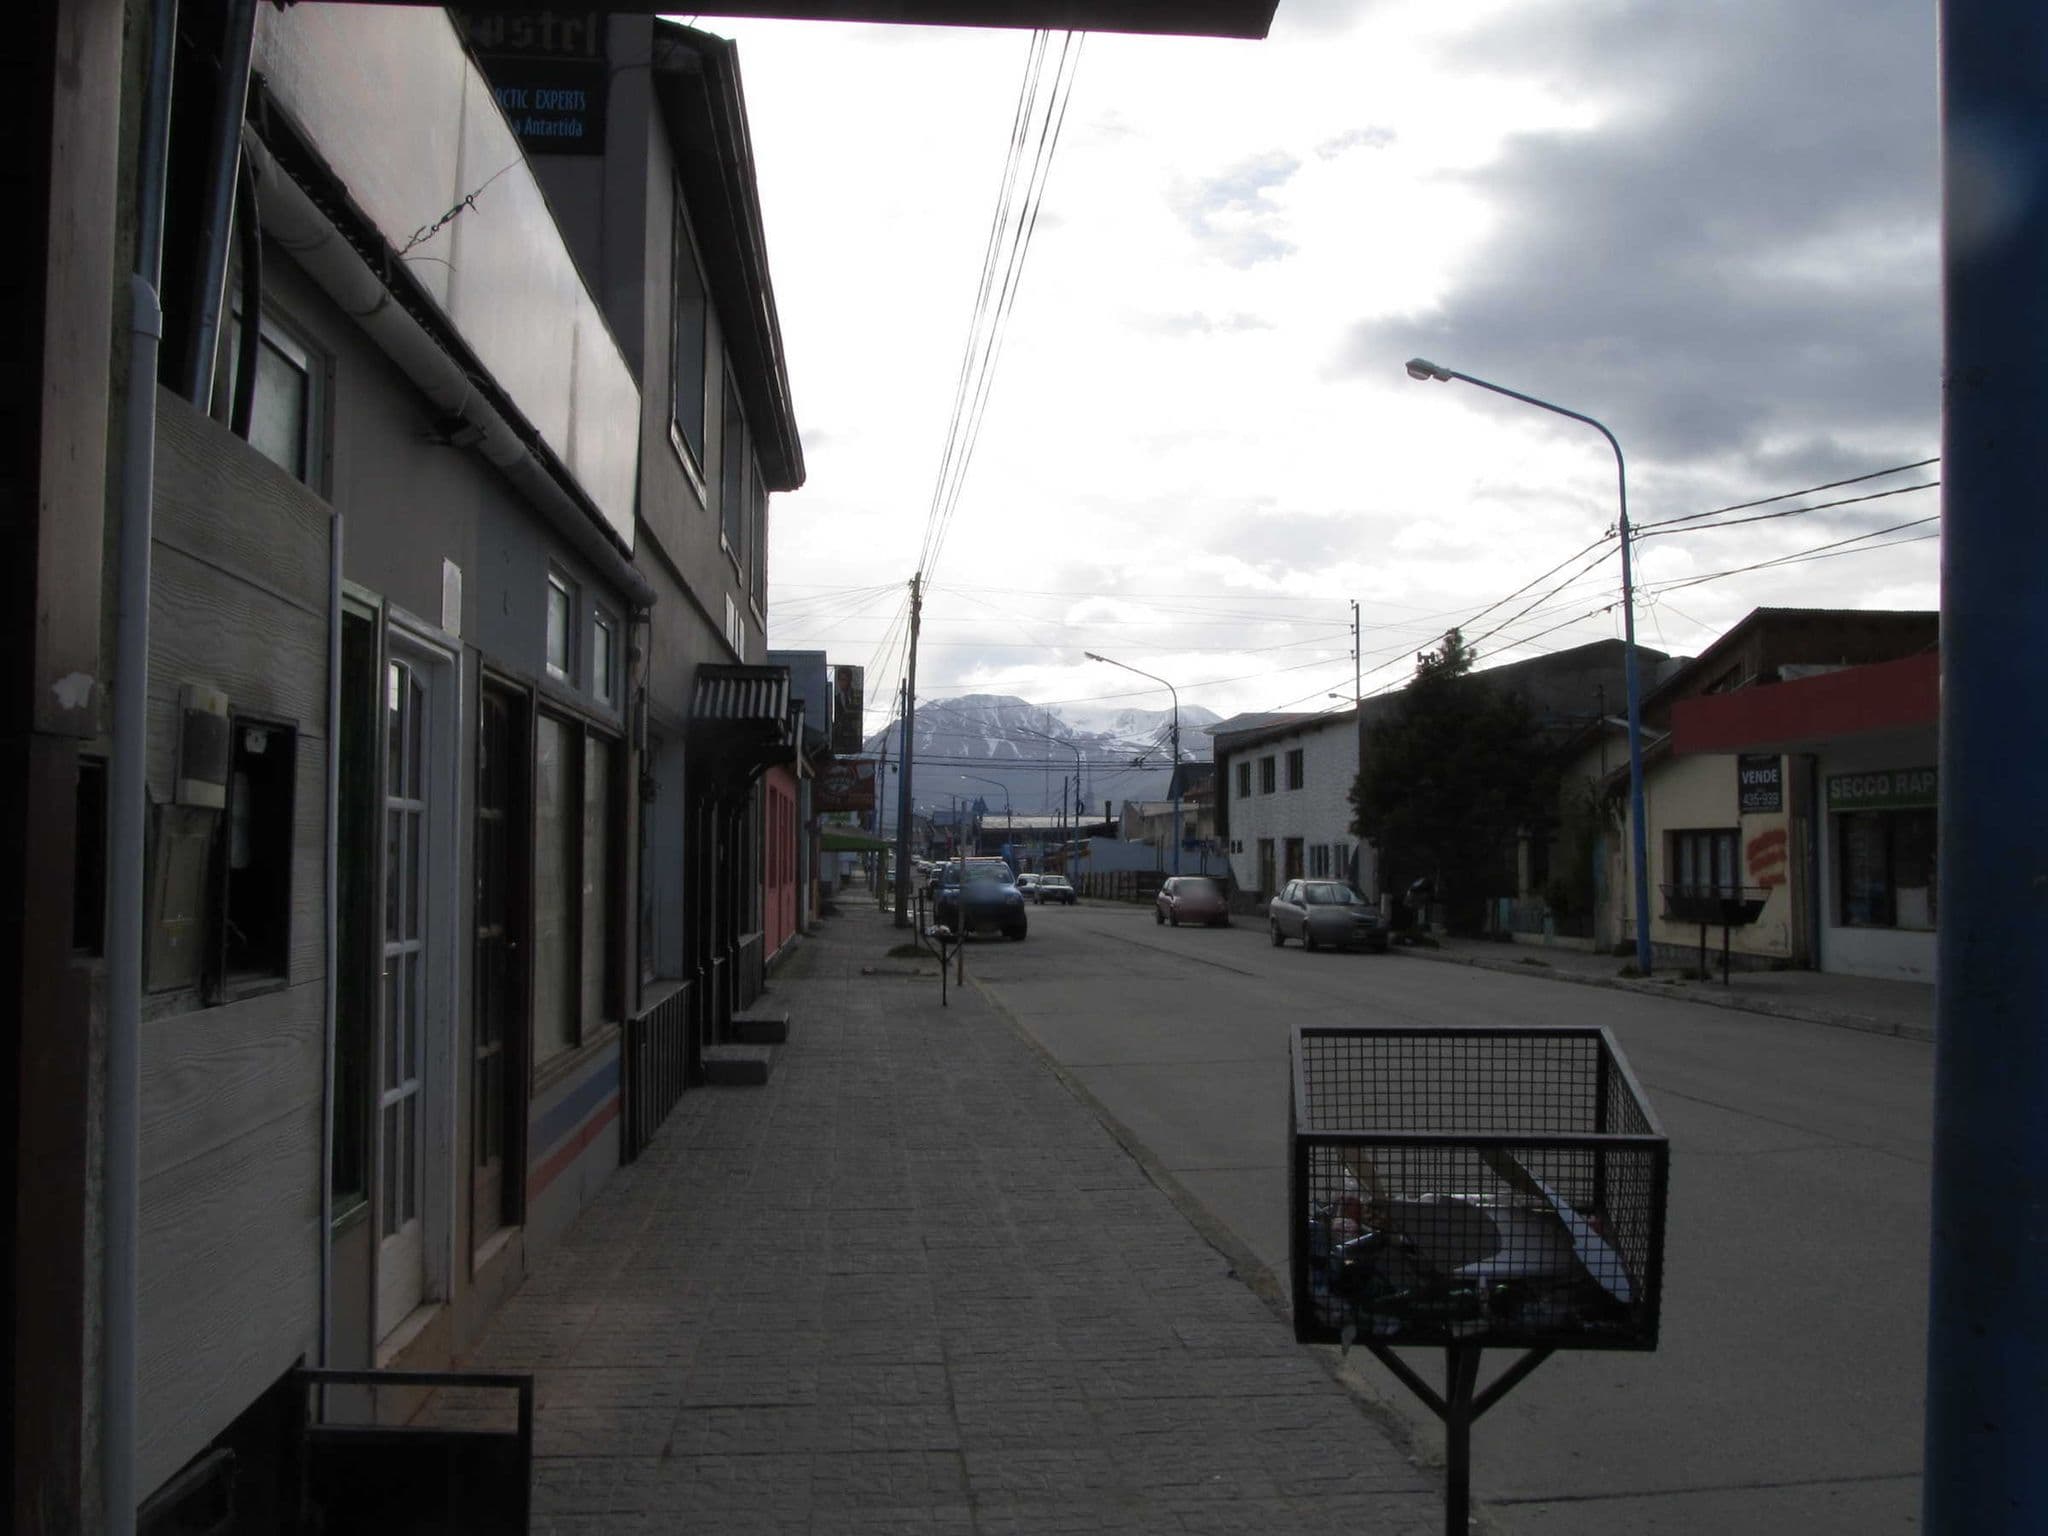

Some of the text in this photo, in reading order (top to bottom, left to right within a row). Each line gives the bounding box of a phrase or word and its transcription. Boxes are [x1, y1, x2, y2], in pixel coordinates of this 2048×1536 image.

[535, 88, 586, 110] EXPERTS
[1742, 767, 1778, 785] VENDE
[1831, 775, 1889, 800] SECCO
